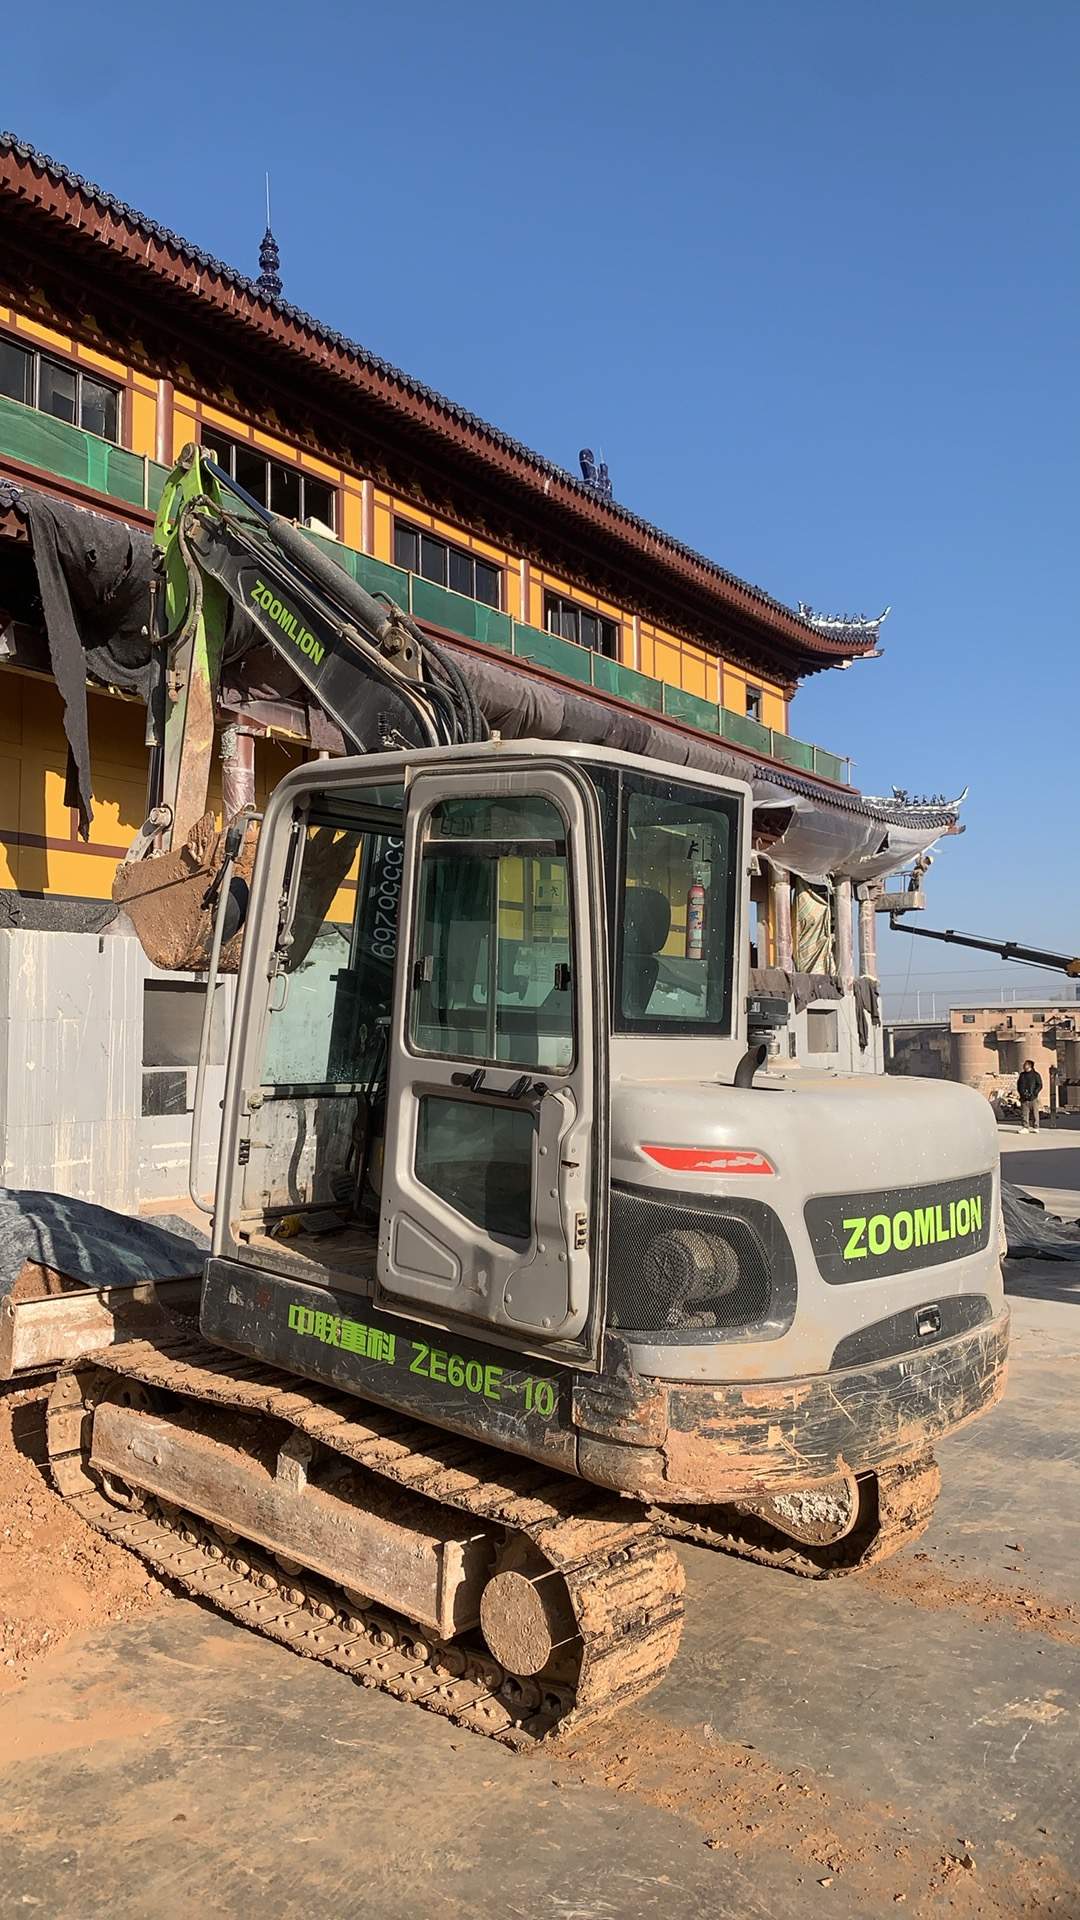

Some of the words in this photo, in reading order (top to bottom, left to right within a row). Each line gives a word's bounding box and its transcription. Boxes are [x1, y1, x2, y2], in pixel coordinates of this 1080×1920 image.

[250, 579, 325, 665] ZOOMLION
[843, 1195, 982, 1260] ZOOMLION
[288, 1304, 396, 1365] 中联重科
